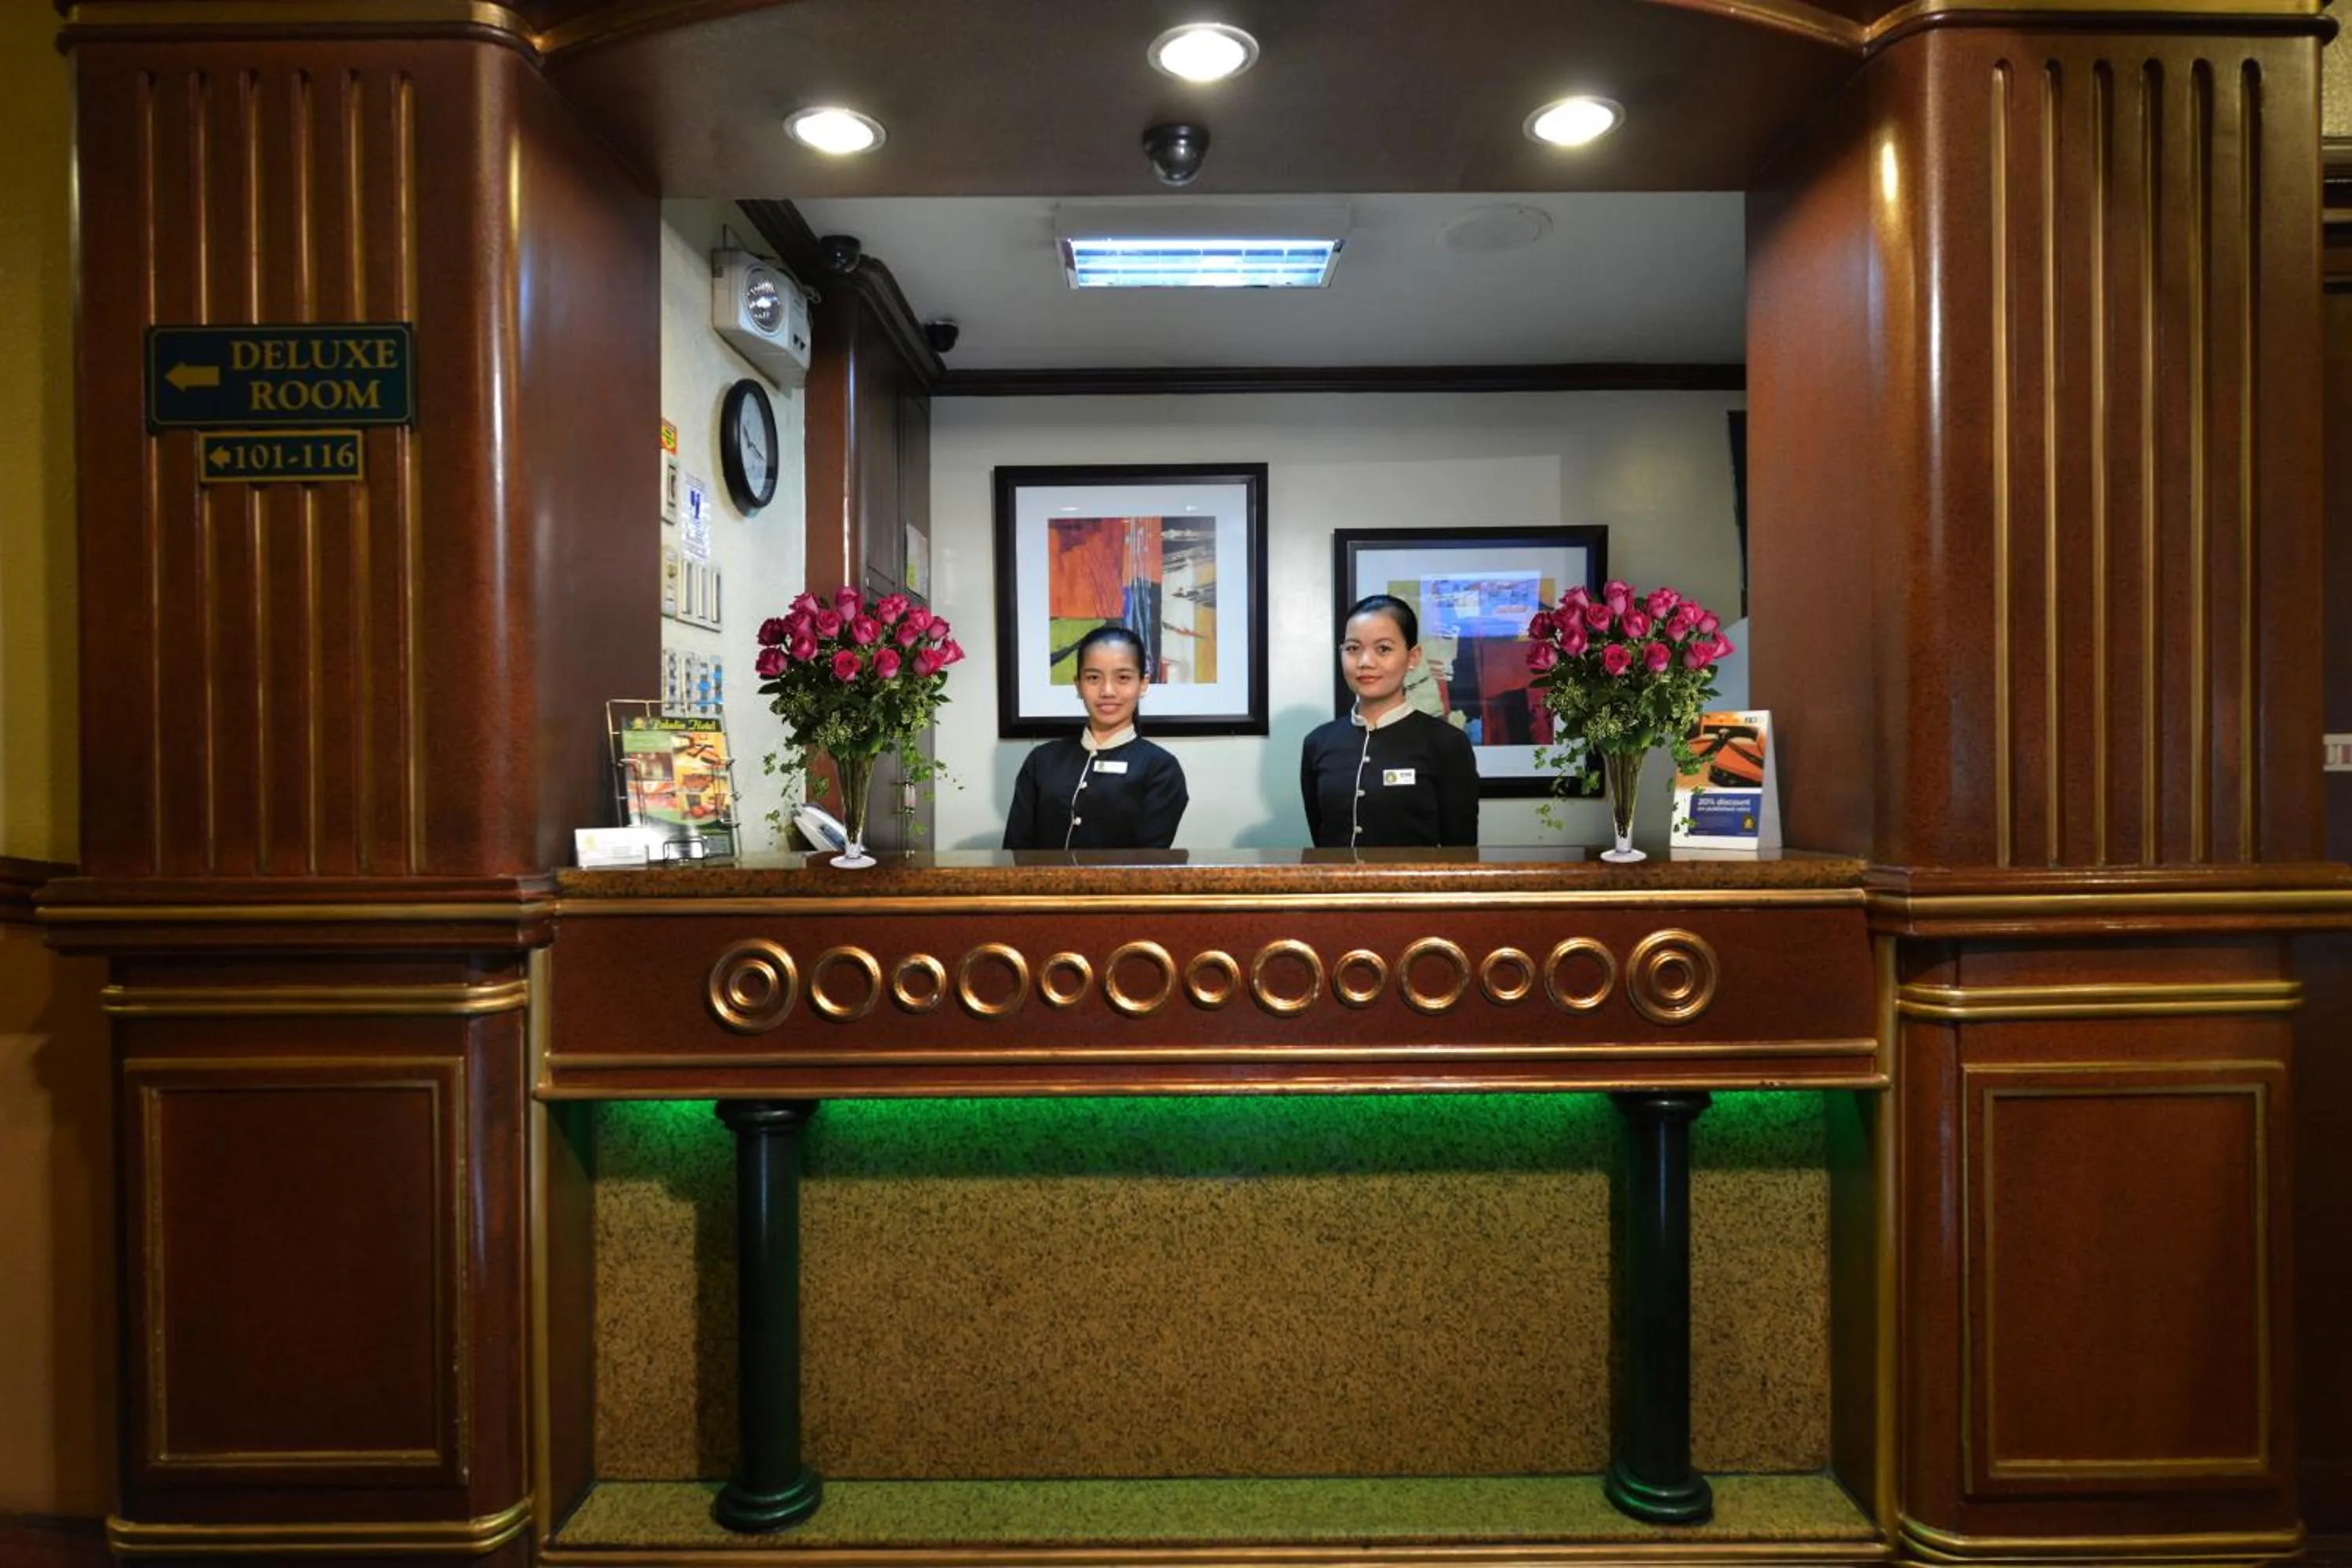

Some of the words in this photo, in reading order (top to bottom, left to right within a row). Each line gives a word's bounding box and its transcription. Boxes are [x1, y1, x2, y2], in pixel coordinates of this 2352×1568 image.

[230, 338, 399, 371] DELUXE
[249, 379, 382, 411] ROOM
[235, 441, 355, 470] 101-116
[1716, 797, 1751, 806] discount
